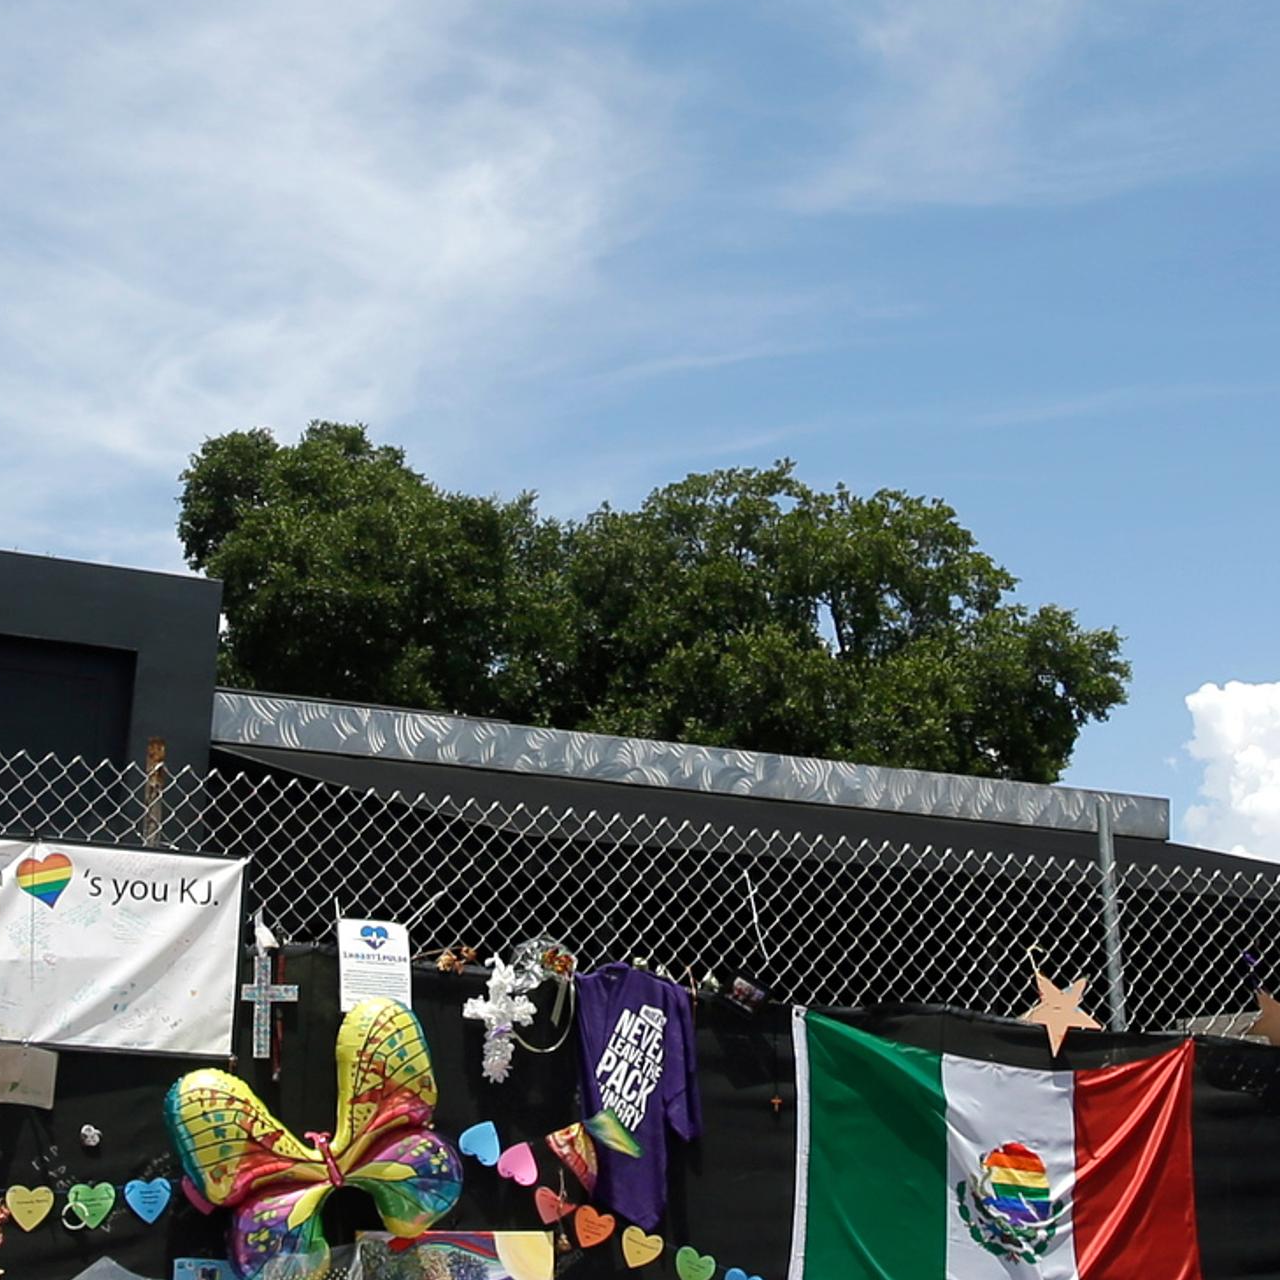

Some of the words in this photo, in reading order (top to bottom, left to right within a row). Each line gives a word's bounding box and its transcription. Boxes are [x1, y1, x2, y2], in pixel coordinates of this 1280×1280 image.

[111, 879, 169, 906] you
[178, 876, 220, 907] KJ.
[607, 1033, 644, 1069] LEAVE
[595, 1047, 657, 1114] PACK
